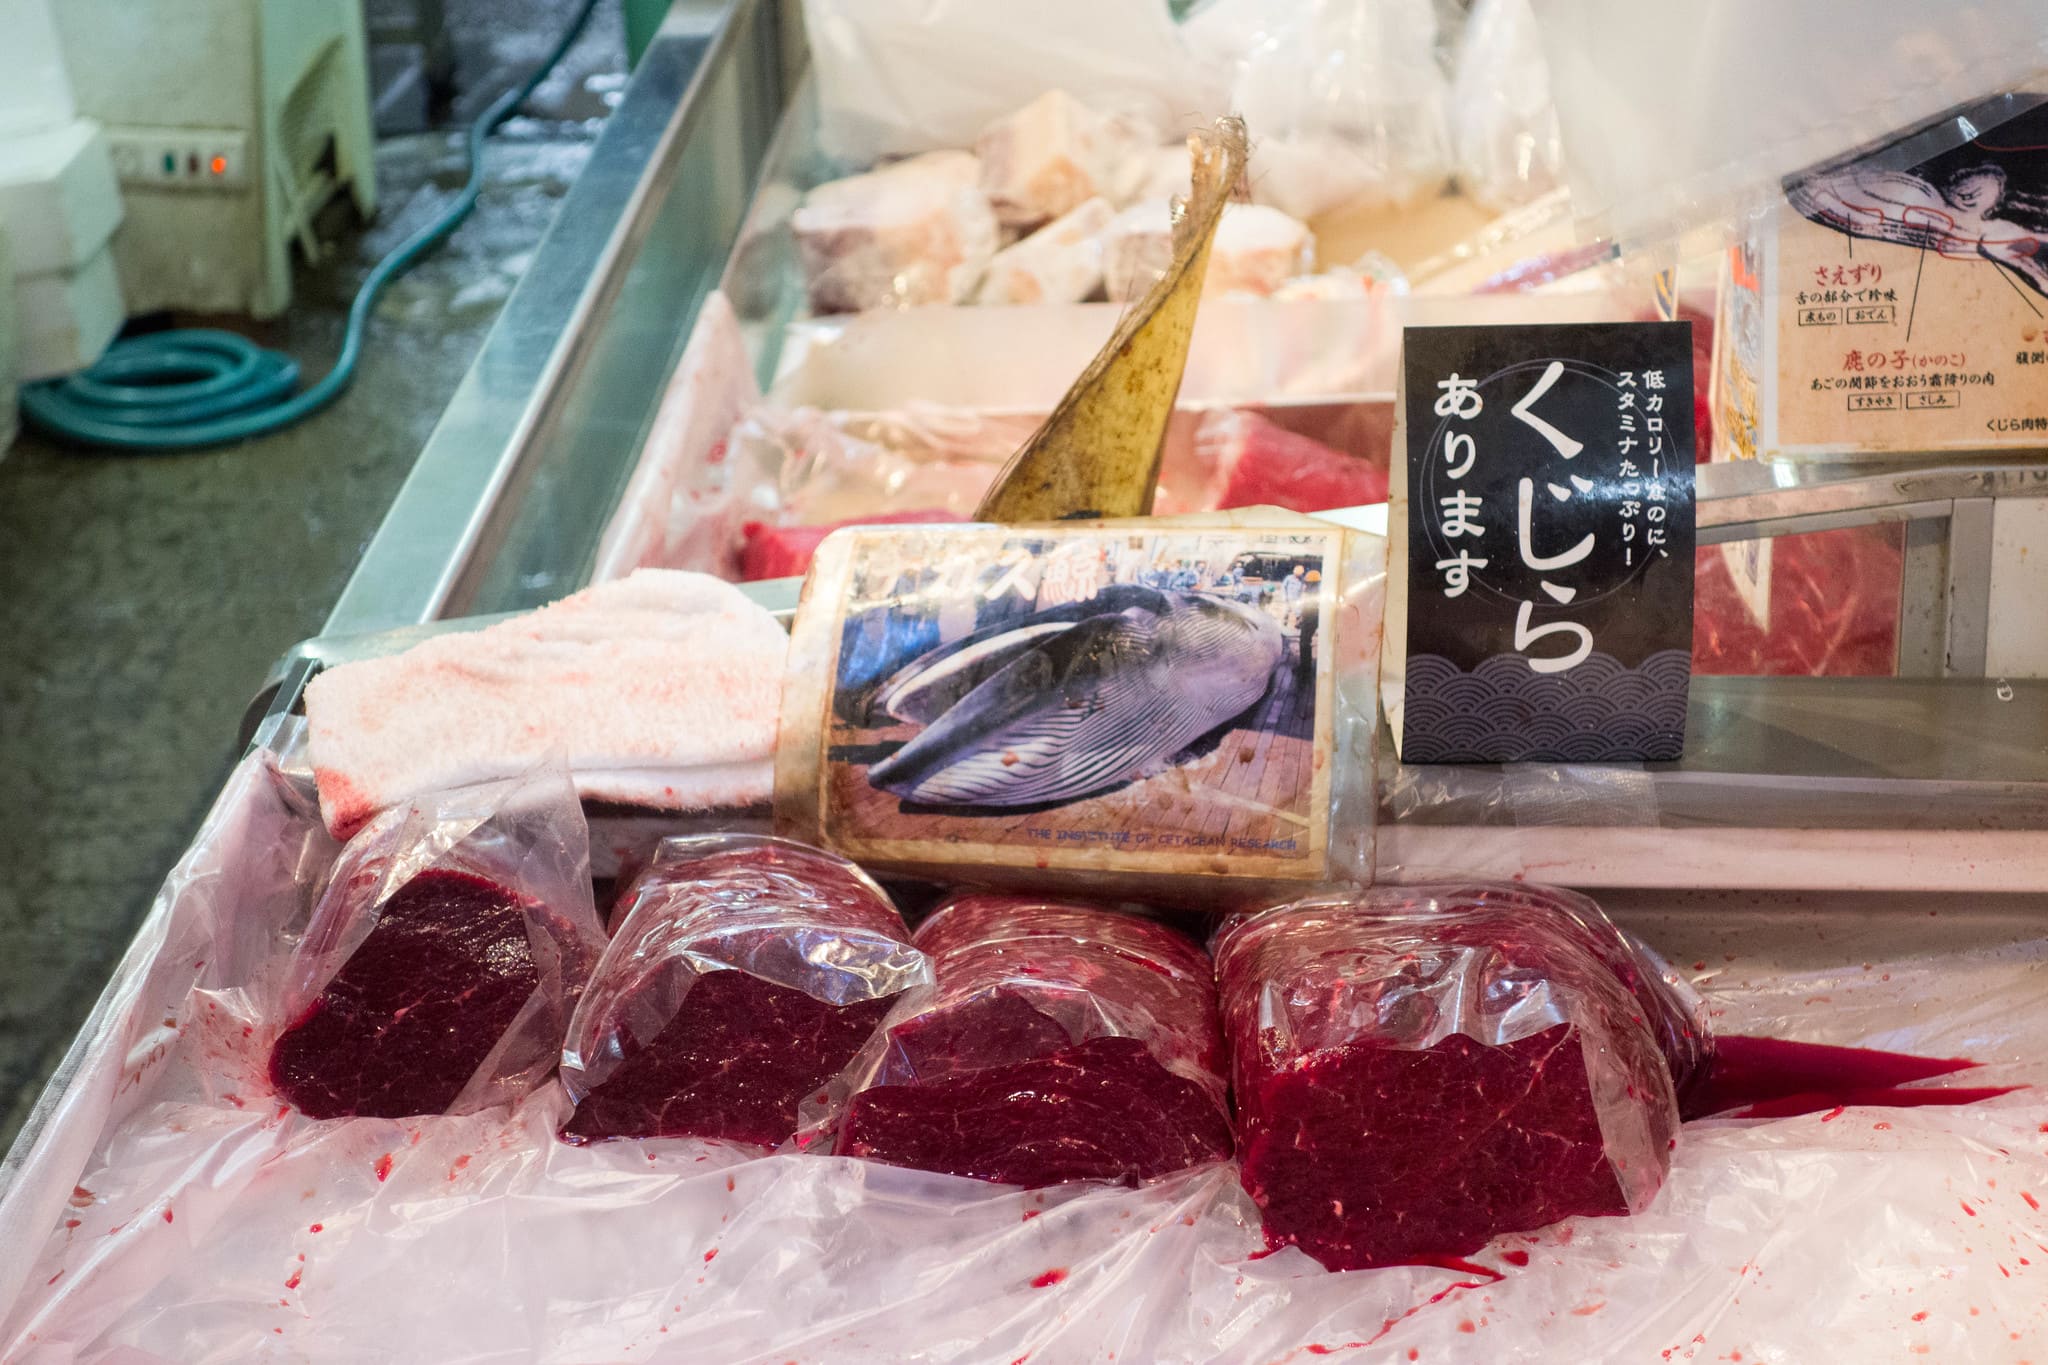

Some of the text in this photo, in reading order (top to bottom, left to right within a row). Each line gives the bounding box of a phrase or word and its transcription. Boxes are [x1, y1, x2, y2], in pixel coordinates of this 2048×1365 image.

[1814, 263, 1882, 286] さえずり
[1795, 288, 1898, 305] 舌の部分で珍味
[1855, 309, 1887, 320] おでん
[2016, 350, 2048, 364] 腹側
[1810, 371, 1995, 391] あごの関節をおおう霜降りの肉
[1855, 395, 1946, 407] すきやき さしみ
[1642, 370, 1668, 558] 低カロリーなのに、
[1434, 373, 1488, 598] あります
[1511, 361, 1595, 673] くじら
[1027, 828, 1050, 840] THE
[1136, 832, 1152, 845] OF
[1157, 834, 1226, 848] CETACEAN
[1230, 837, 1297, 851] RESEARCH
